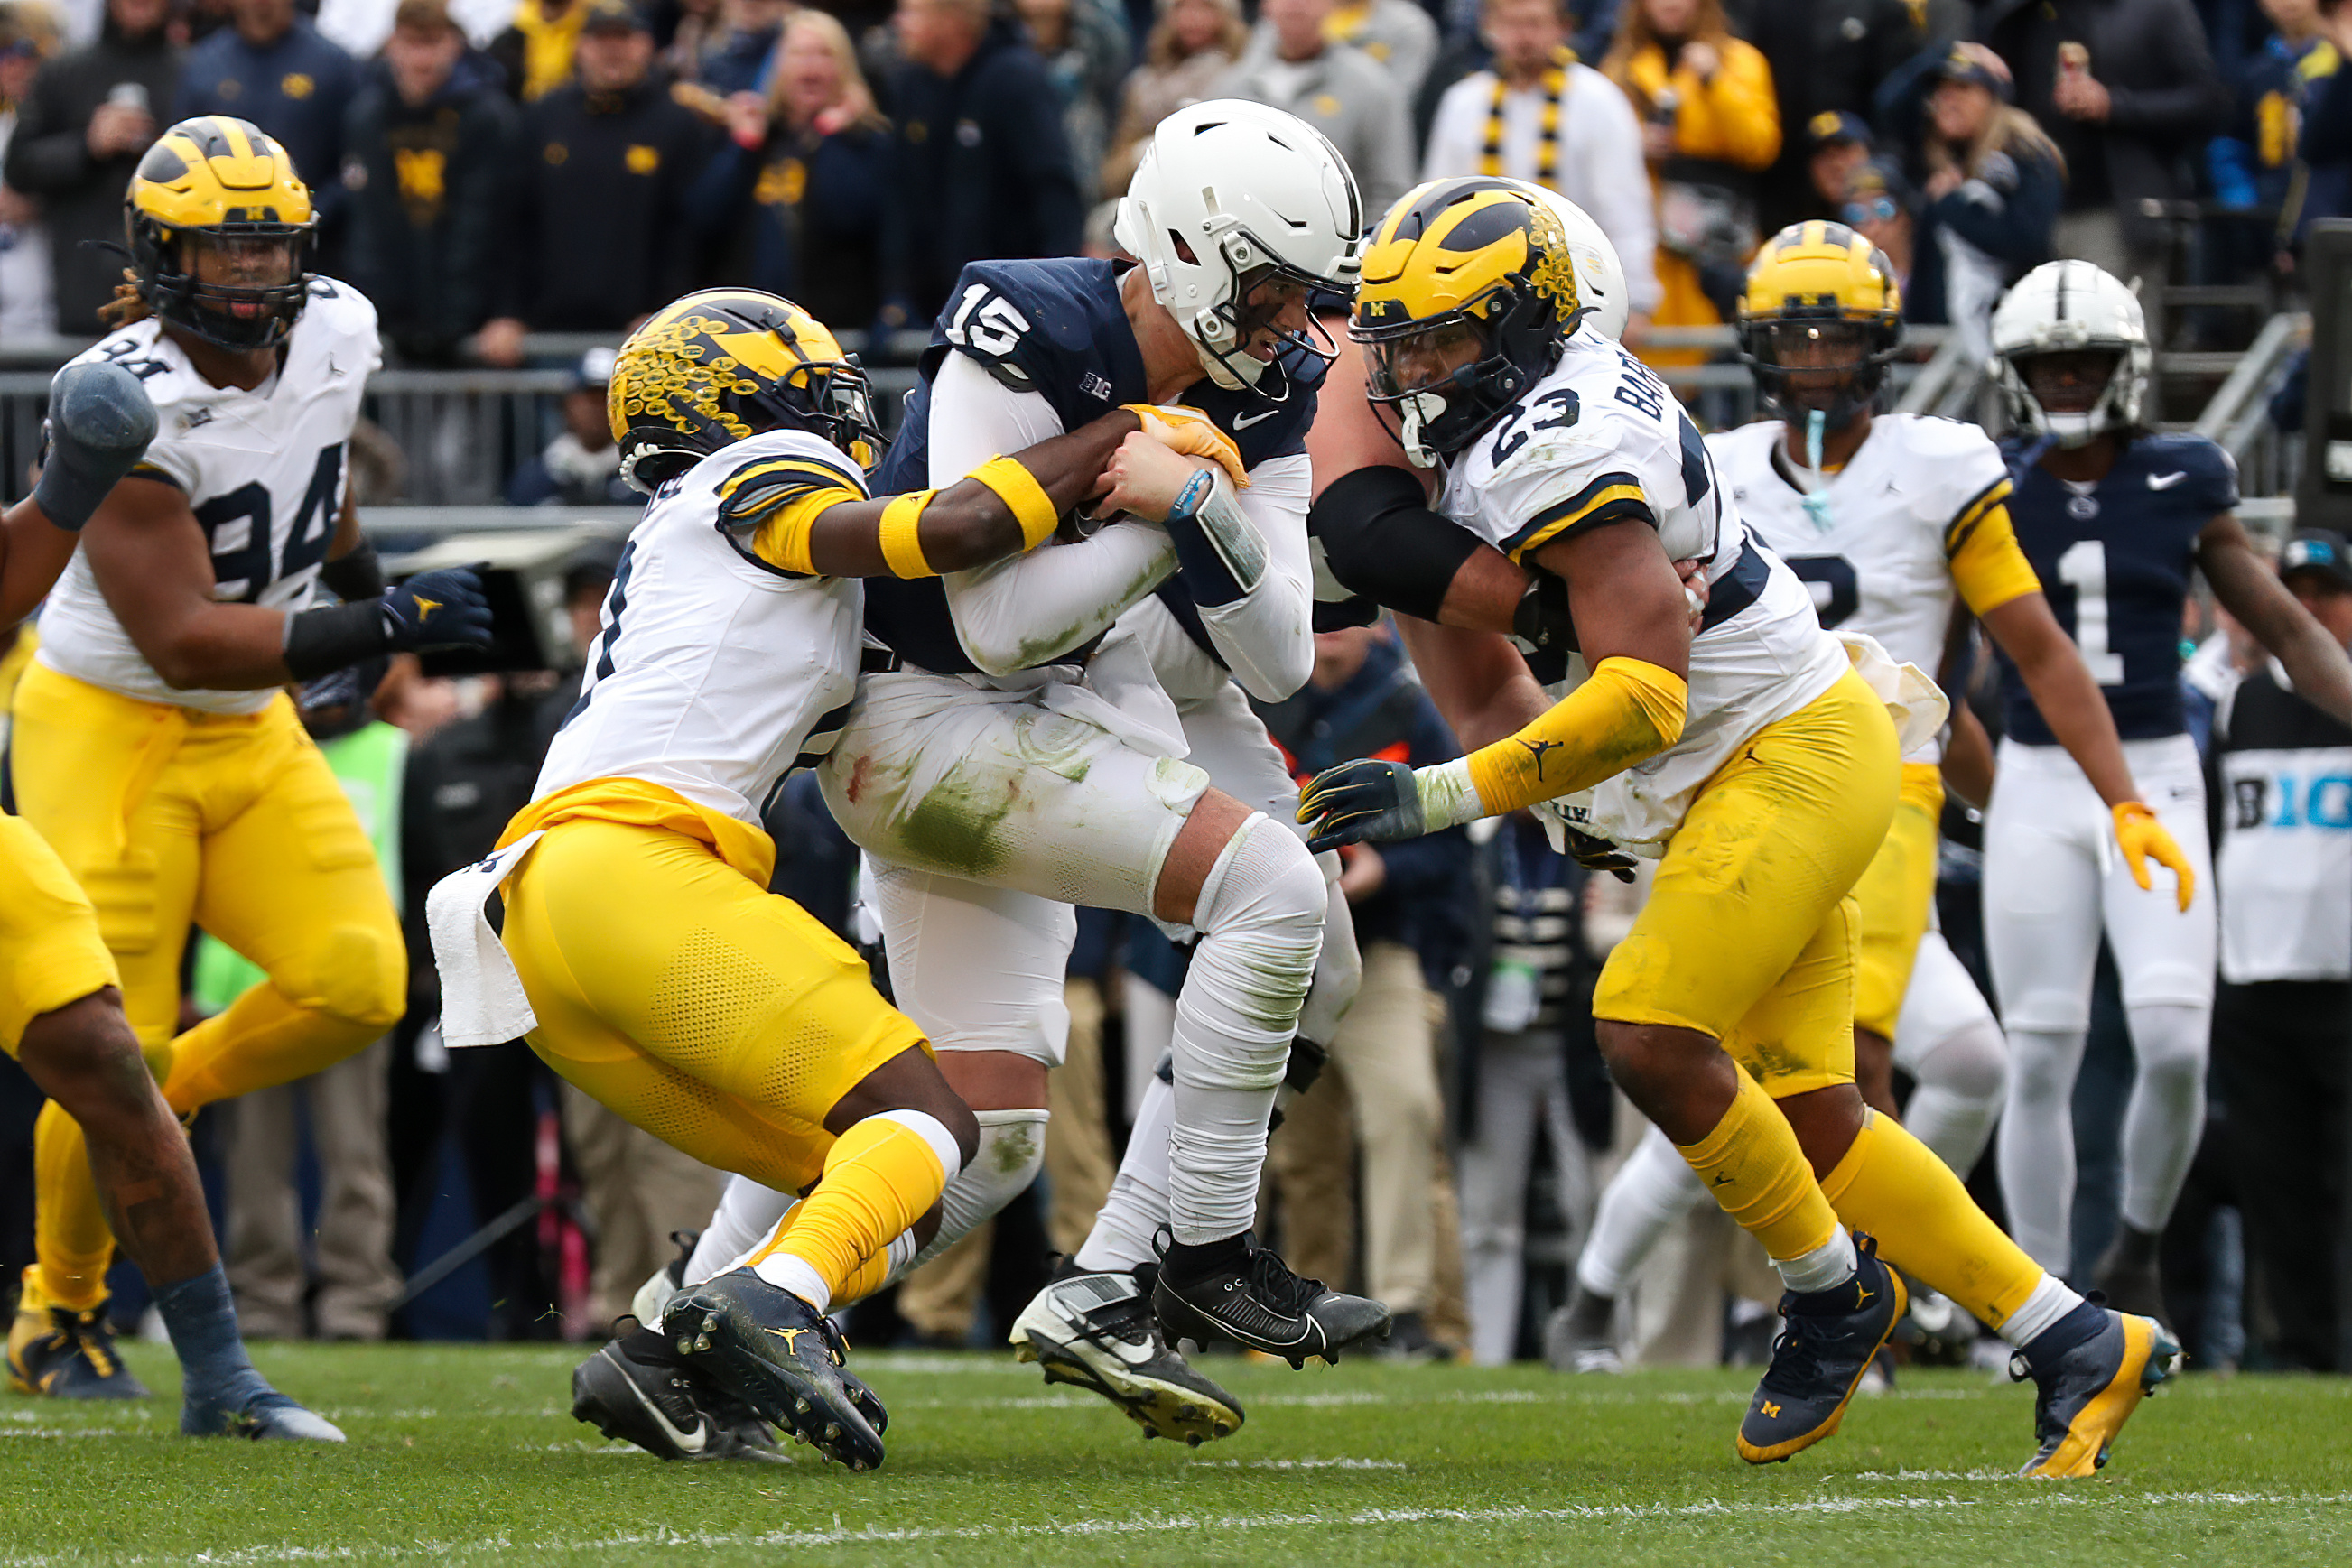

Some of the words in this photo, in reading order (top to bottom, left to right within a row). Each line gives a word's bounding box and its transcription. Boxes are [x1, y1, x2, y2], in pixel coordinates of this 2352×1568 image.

[945, 283, 1031, 357] 15
[1370, 301, 1386, 317] M
[1491, 387, 1580, 469] 23
[190, 442, 349, 602] 94
[2058, 540, 2124, 687] 1
[1761, 1400, 1780, 1418] M
